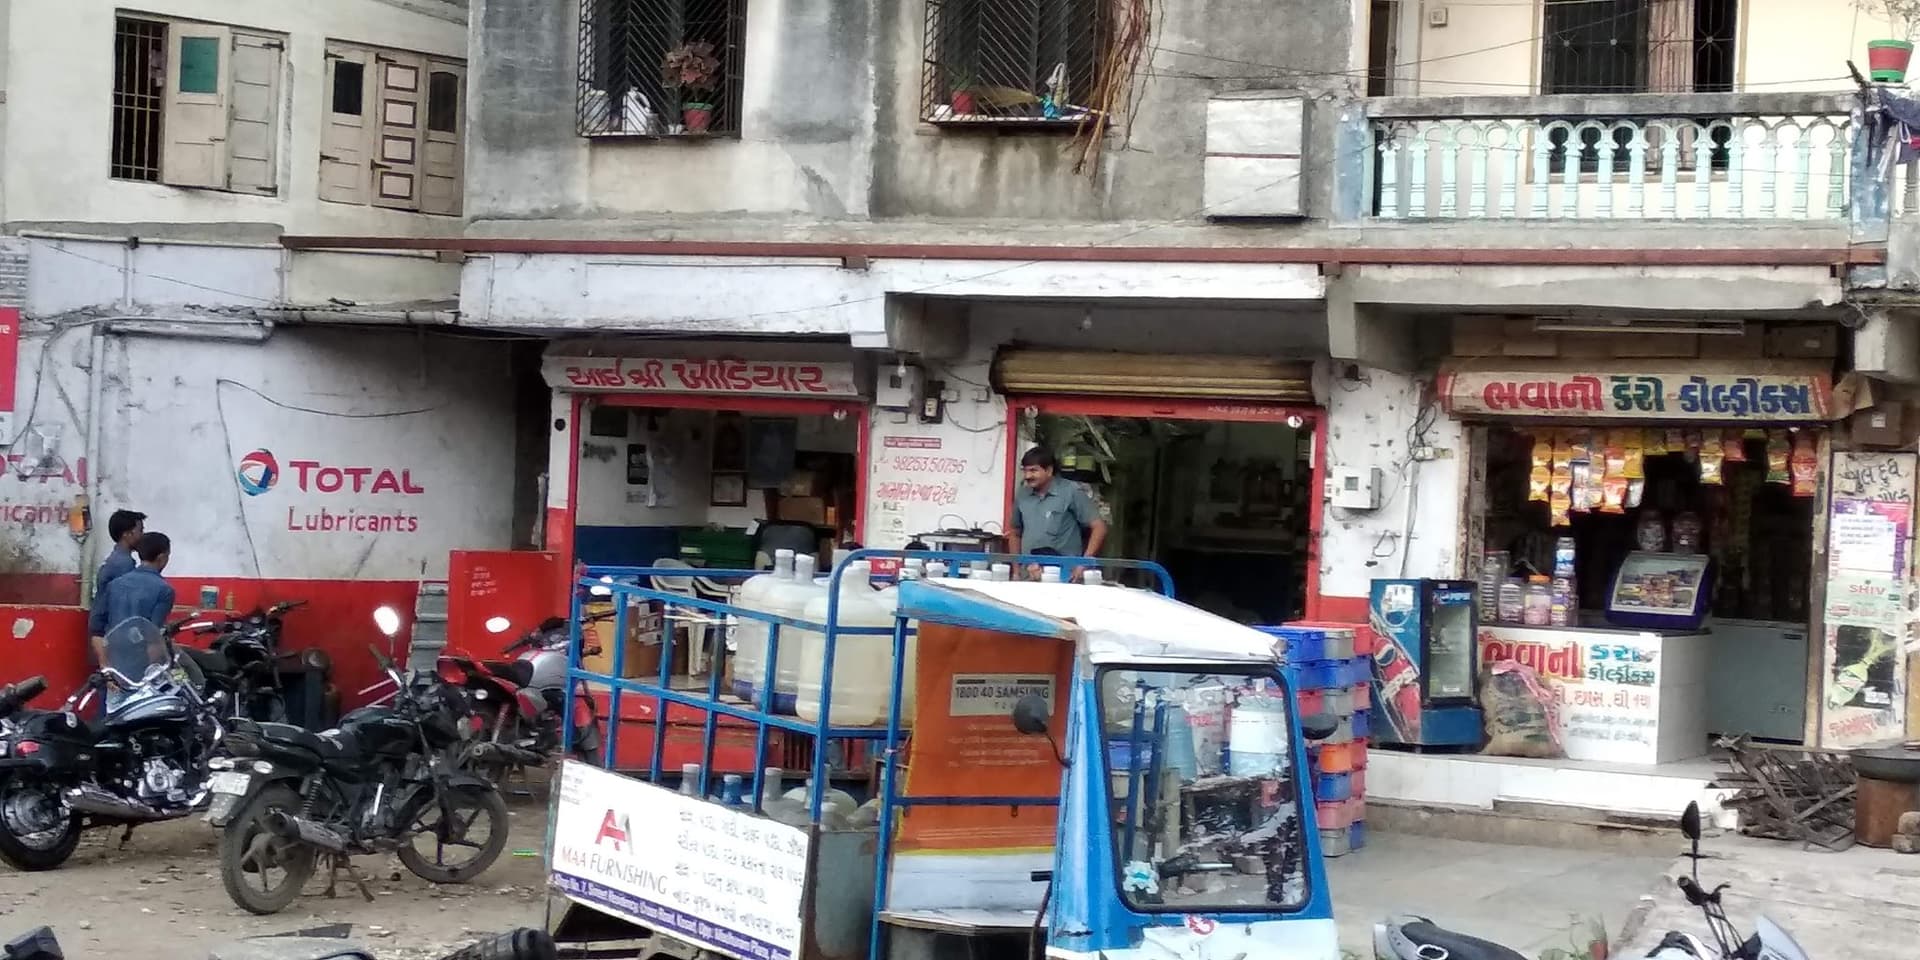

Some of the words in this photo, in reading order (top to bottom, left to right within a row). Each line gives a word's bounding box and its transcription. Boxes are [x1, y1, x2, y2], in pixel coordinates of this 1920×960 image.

[627, 359, 666, 388] શ્રી
[1483, 376, 1605, 411] ભવાની
[289, 460, 424, 494] TOTAL
[288, 505, 419, 532] Lubricants
[1850, 584, 1886, 595] SHIV
[955, 686, 979, 699] 1800
[980, 686, 993, 698] 40
[995, 686, 1049, 698] SAMSUNG
[562, 845, 586, 867] MAA
[590, 853, 668, 895] FURNISHING
